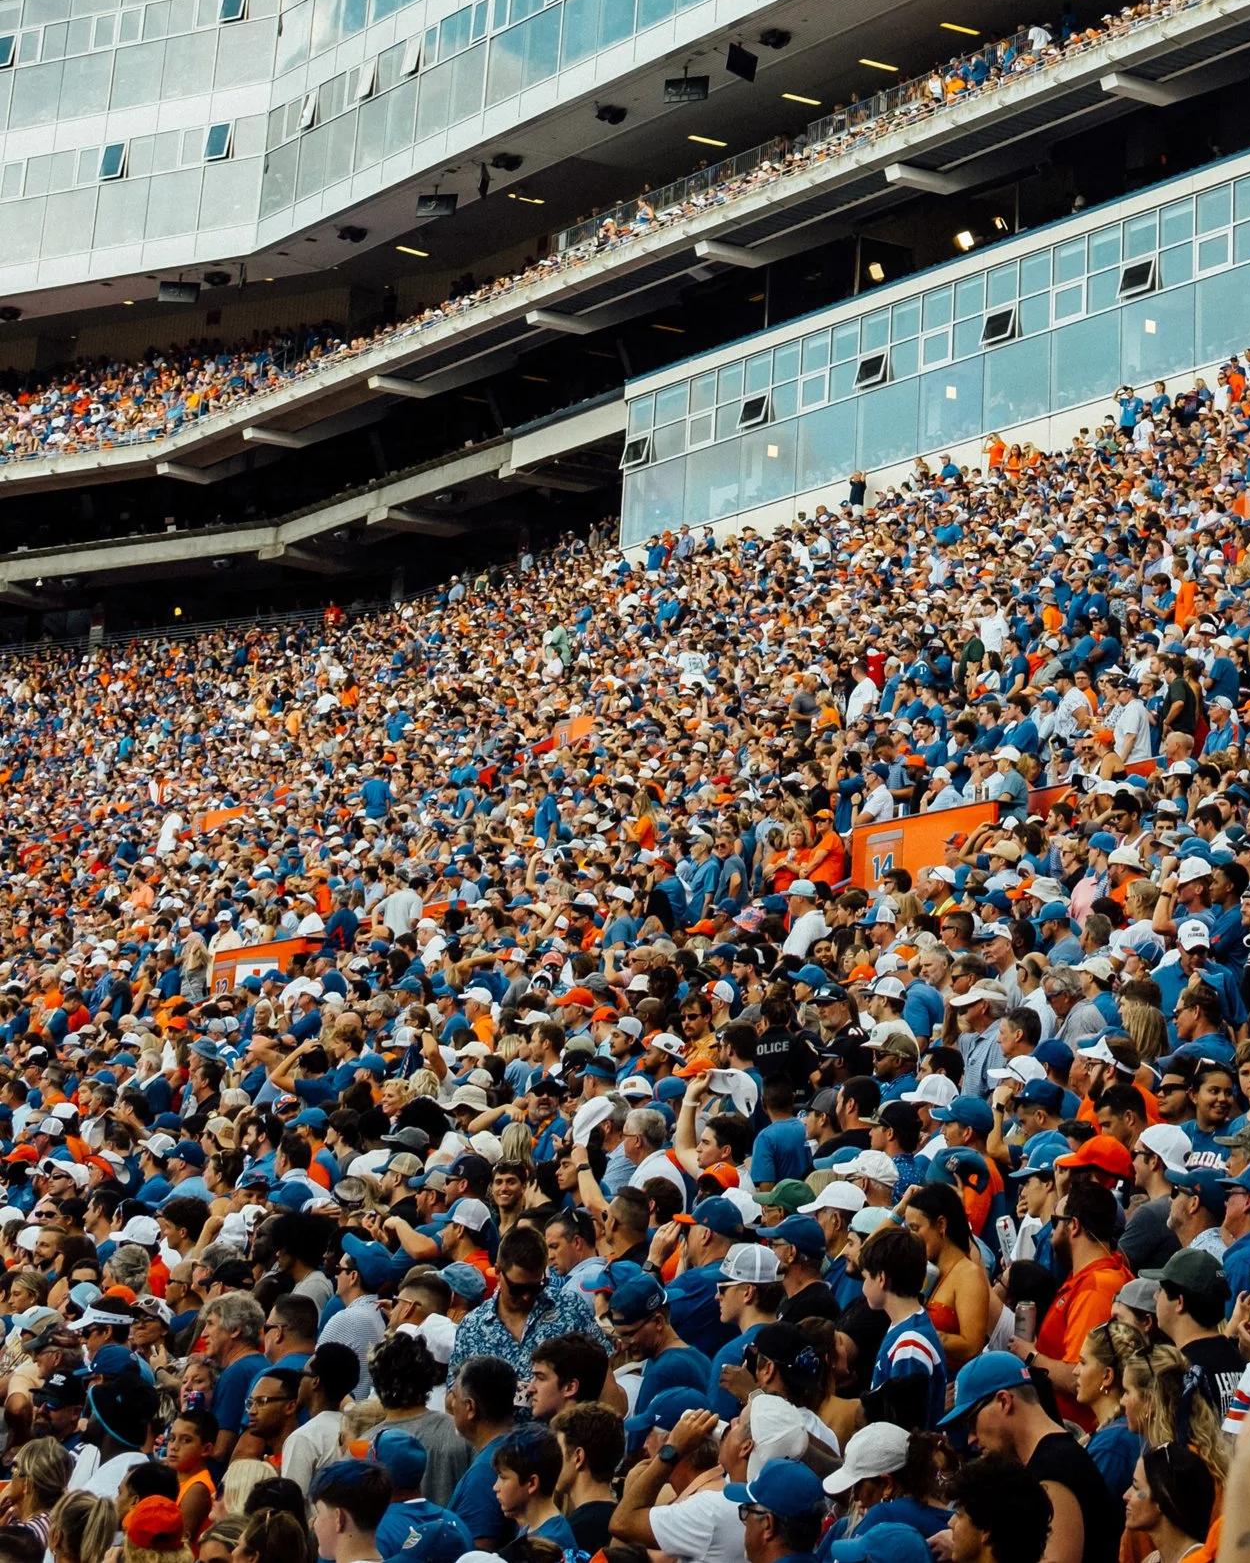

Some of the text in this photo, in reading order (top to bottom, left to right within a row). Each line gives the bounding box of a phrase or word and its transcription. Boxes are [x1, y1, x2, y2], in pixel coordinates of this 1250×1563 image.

[872, 852, 896, 883] 14
[215, 978, 229, 995] 12
[756, 1041, 790, 1056] OLICE
